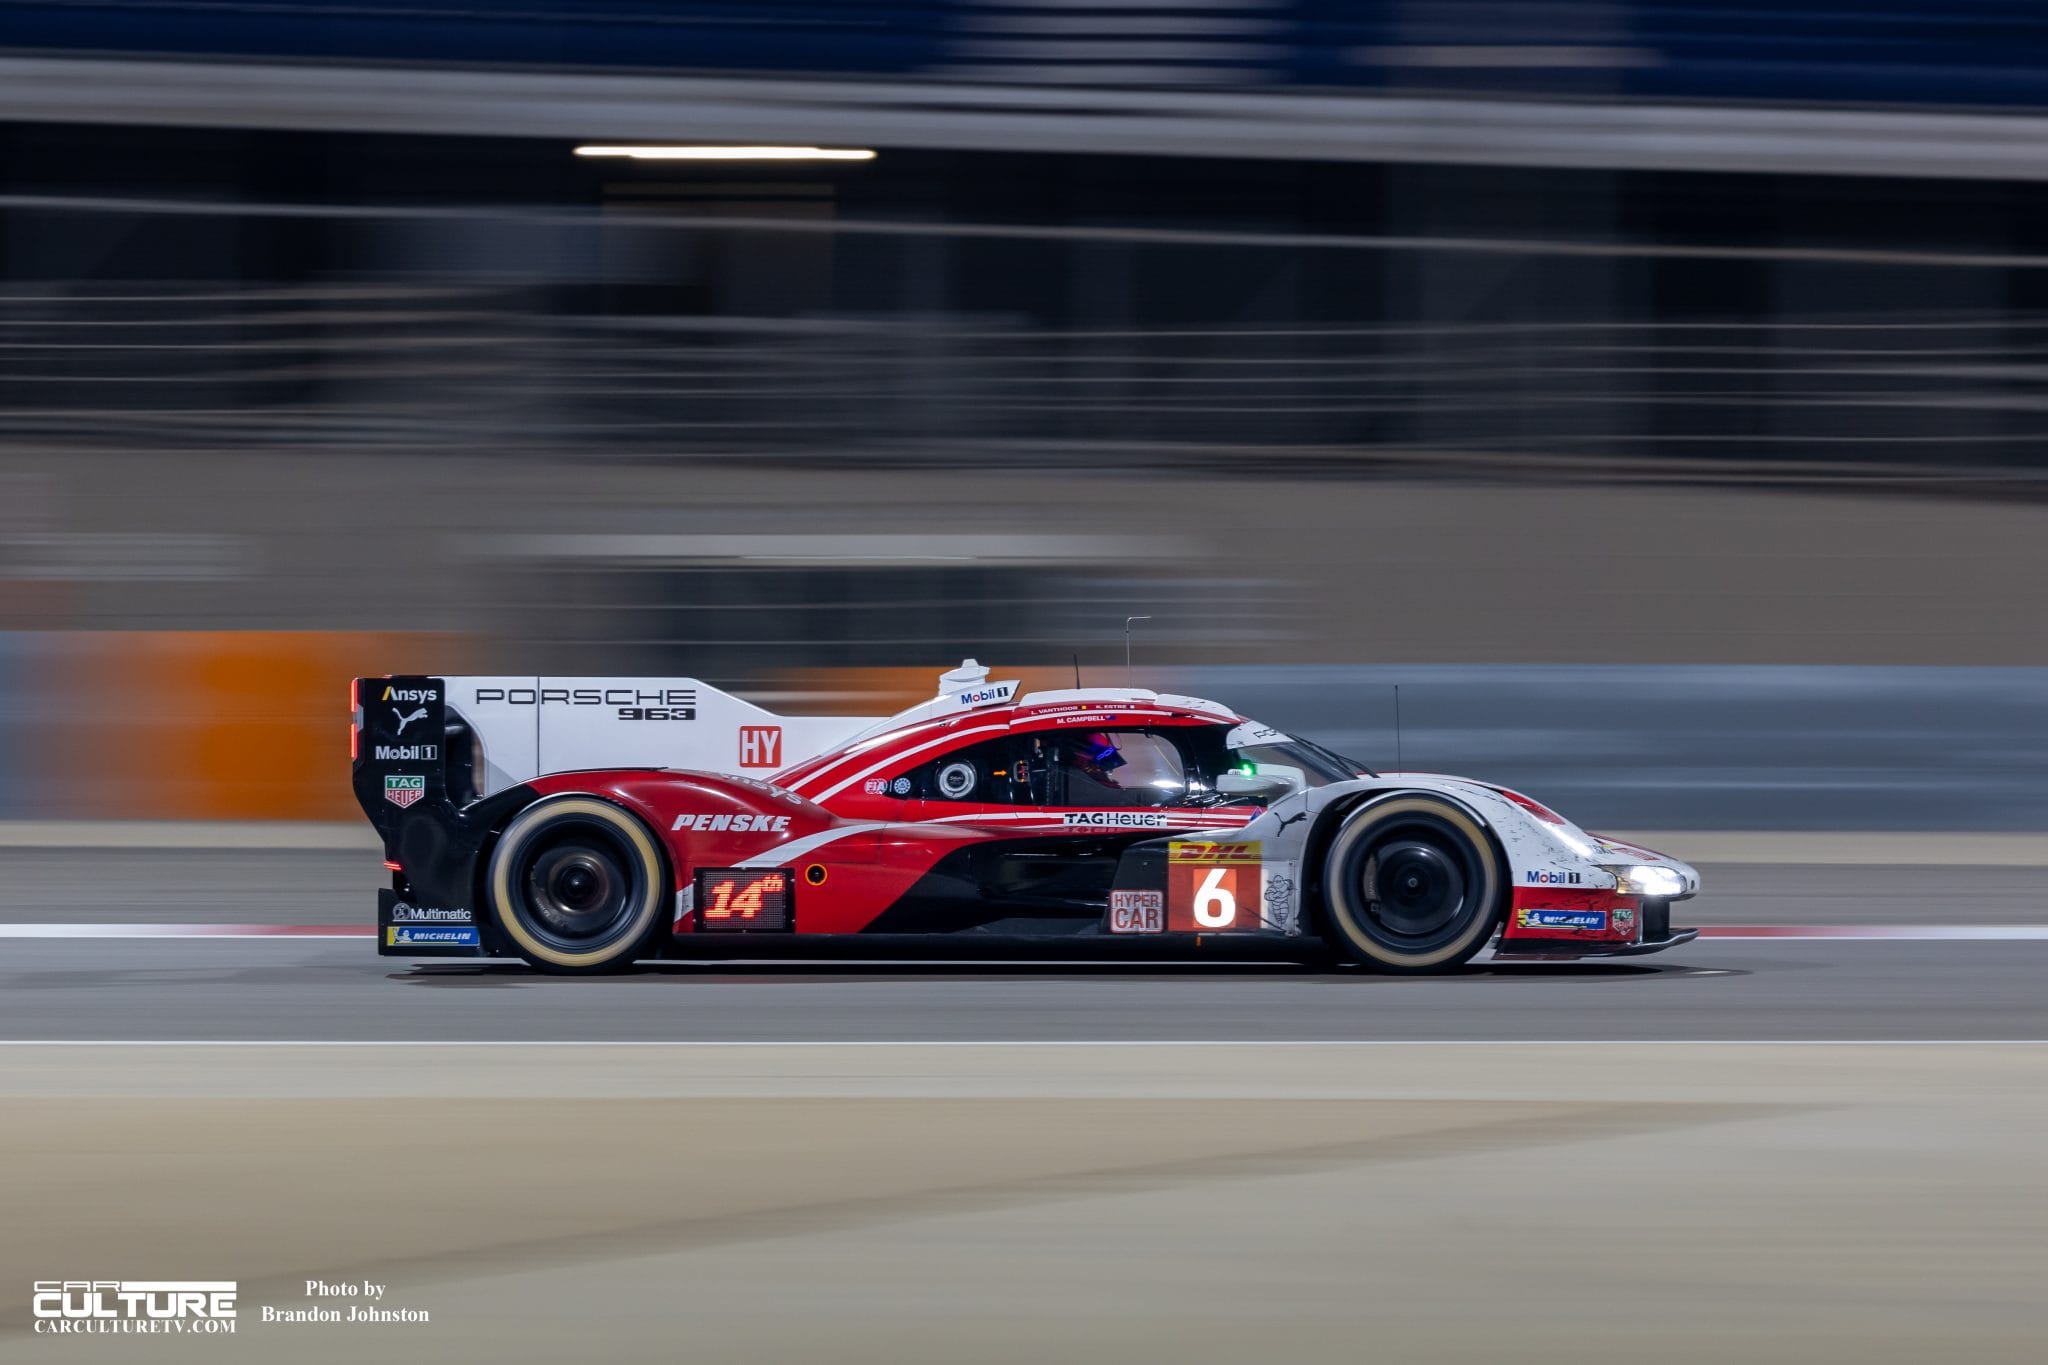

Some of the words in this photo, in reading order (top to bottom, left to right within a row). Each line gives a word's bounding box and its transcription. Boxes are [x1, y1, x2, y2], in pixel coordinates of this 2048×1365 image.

[381, 686, 437, 704] Ansys
[476, 689, 697, 705] PORSCHE
[961, 690, 996, 704] Mobil
[618, 708, 697, 721] 963
[1067, 715, 1106, 724] CAMPBELL
[375, 746, 419, 760] Mobil
[741, 730, 780, 764] HY
[388, 778, 421, 788] TAG
[387, 789, 423, 804] HEUER
[671, 814, 792, 832] PENSKE
[1178, 844, 1248, 859] DHL
[1527, 871, 1566, 884] Mobil
[1115, 894, 1159, 907] HYPER
[1193, 868, 1236, 928] 6
[410, 908, 472, 920] Multimatic
[1115, 908, 1158, 929] CAR
[413, 932, 471, 940] MICHELIN
